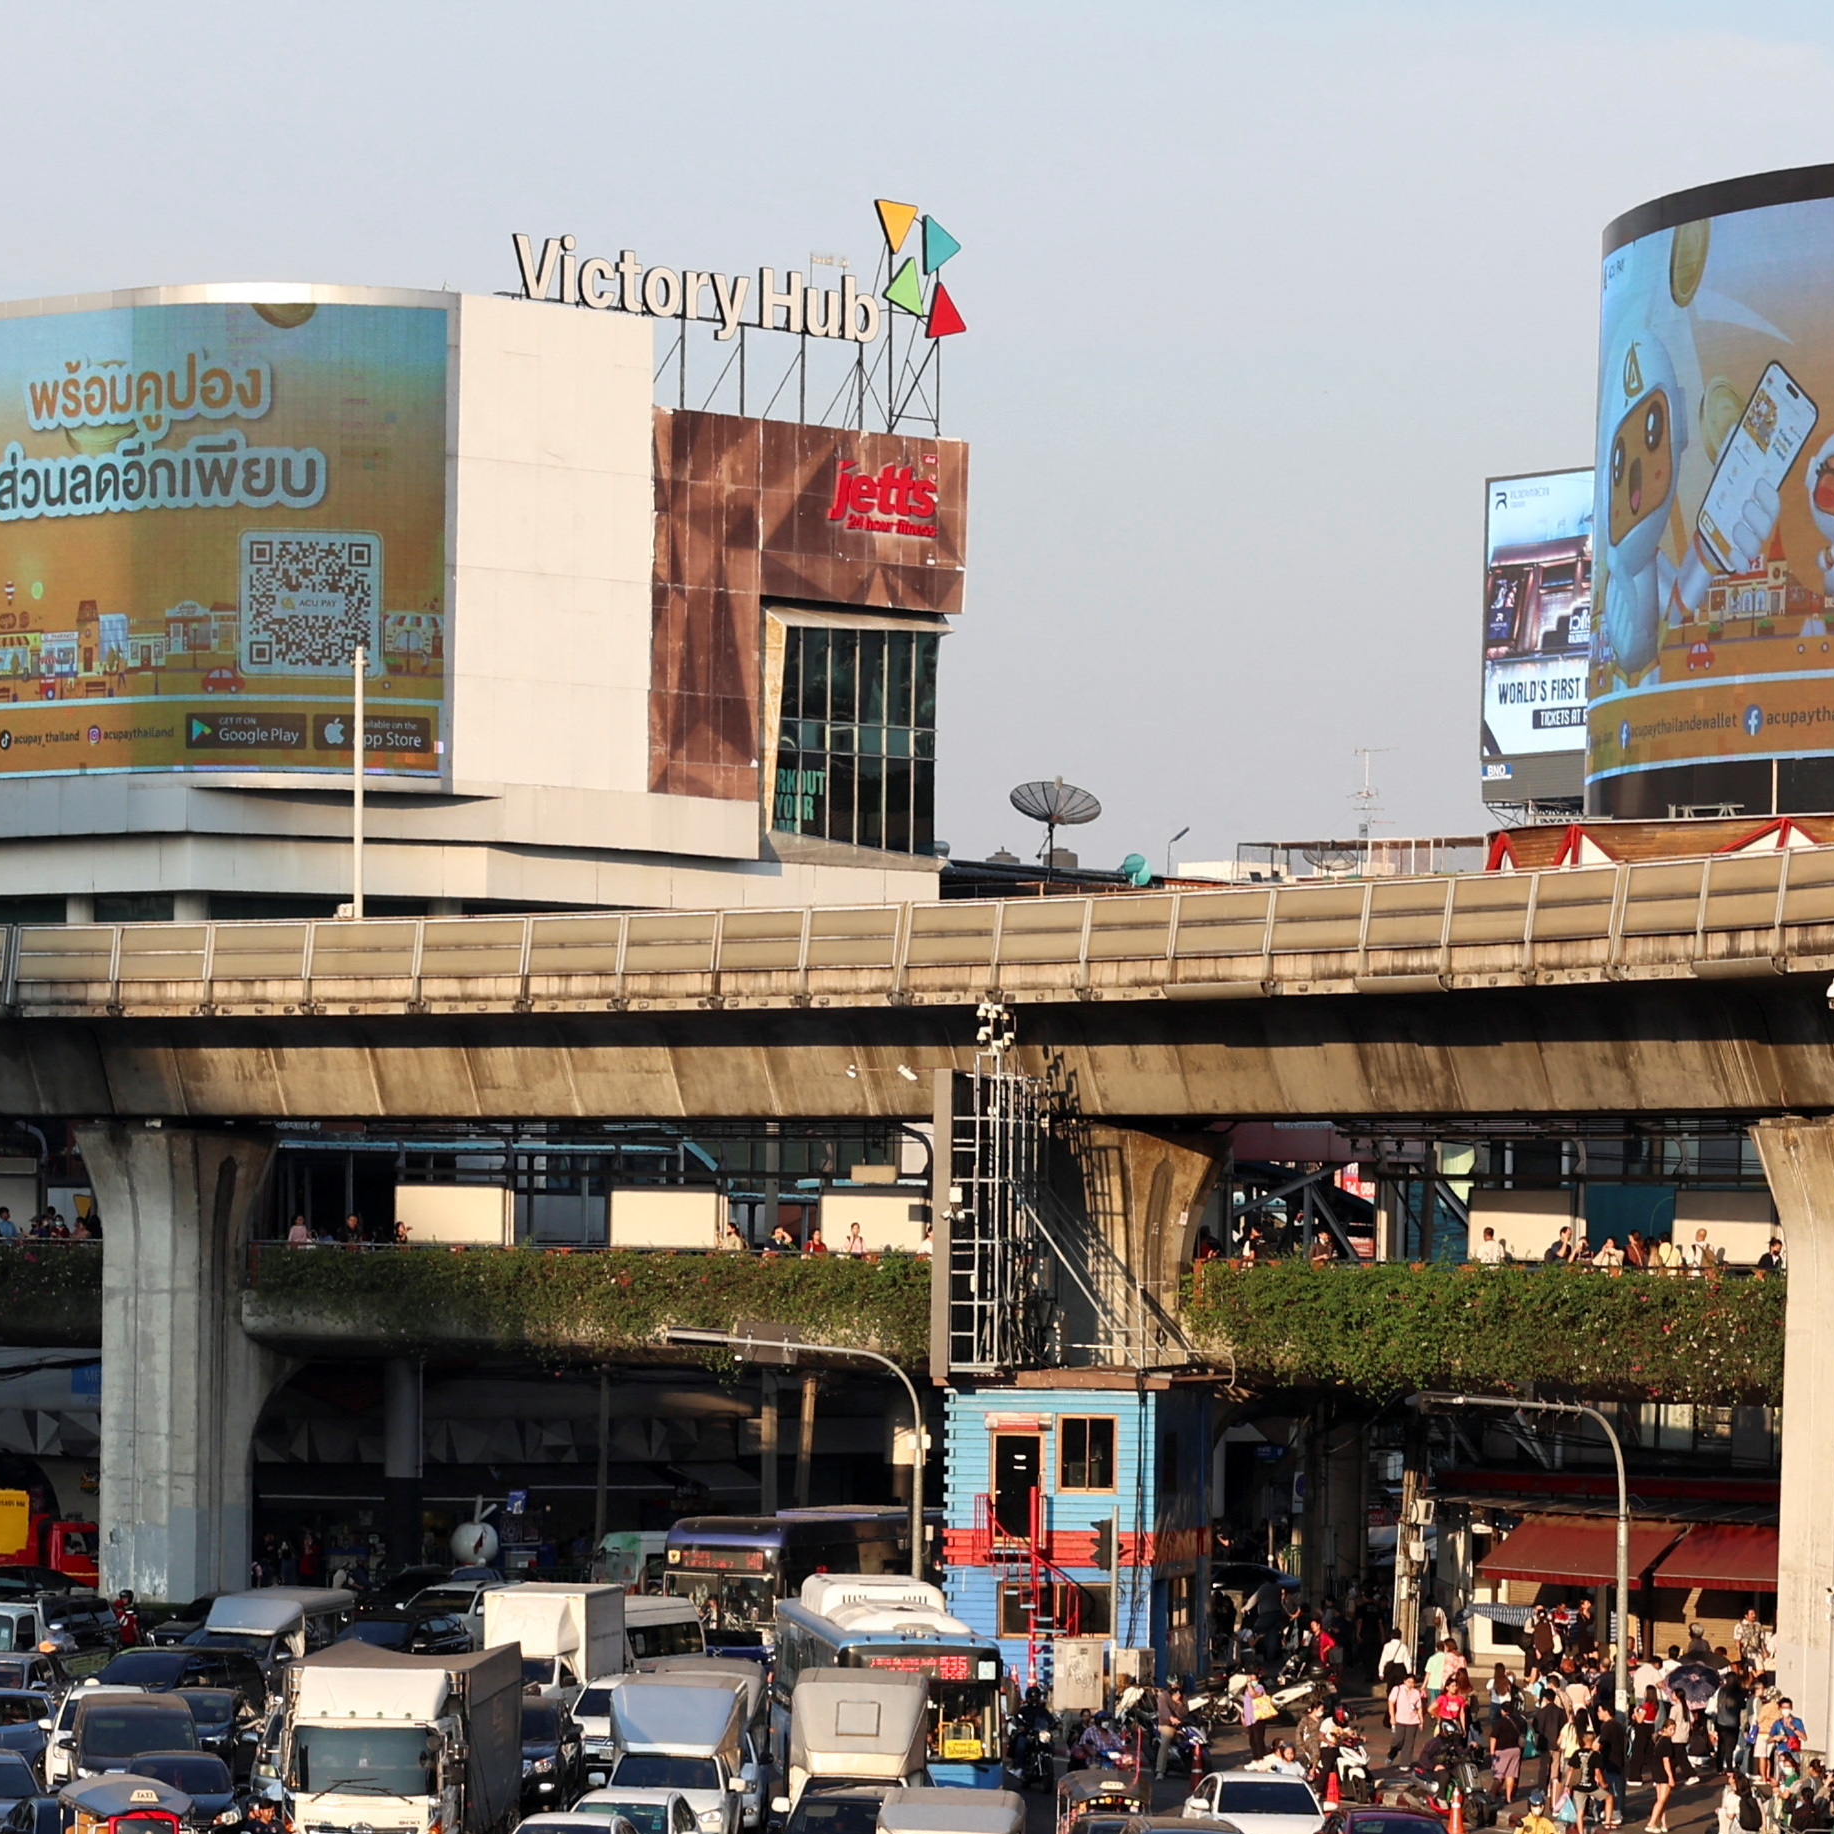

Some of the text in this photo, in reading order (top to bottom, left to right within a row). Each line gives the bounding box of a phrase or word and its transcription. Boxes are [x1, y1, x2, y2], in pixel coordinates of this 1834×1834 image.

[513, 233, 880, 343] Victory Hub
[30, 353, 262, 431] พร้อมคูปอง
[827, 460, 937, 520] jetts
[1498, 678, 1581, 705] WORLD'S FIRST
[219, 717, 233, 725] GET
[244, 717, 256, 725] ON
[392, 721, 403, 729] on
[406, 721, 417, 730] the
[1540, 709, 1570, 726] TICKETS
[1630, 713, 1737, 739] acupaythailandewallet
[14, 731, 80, 747] acupay_thailand
[103, 726, 174, 741] acupaythailand
[219, 728, 299, 744] Google Play
[353, 732, 421, 749] pp Store
[1488, 764, 1506, 776] BNO
